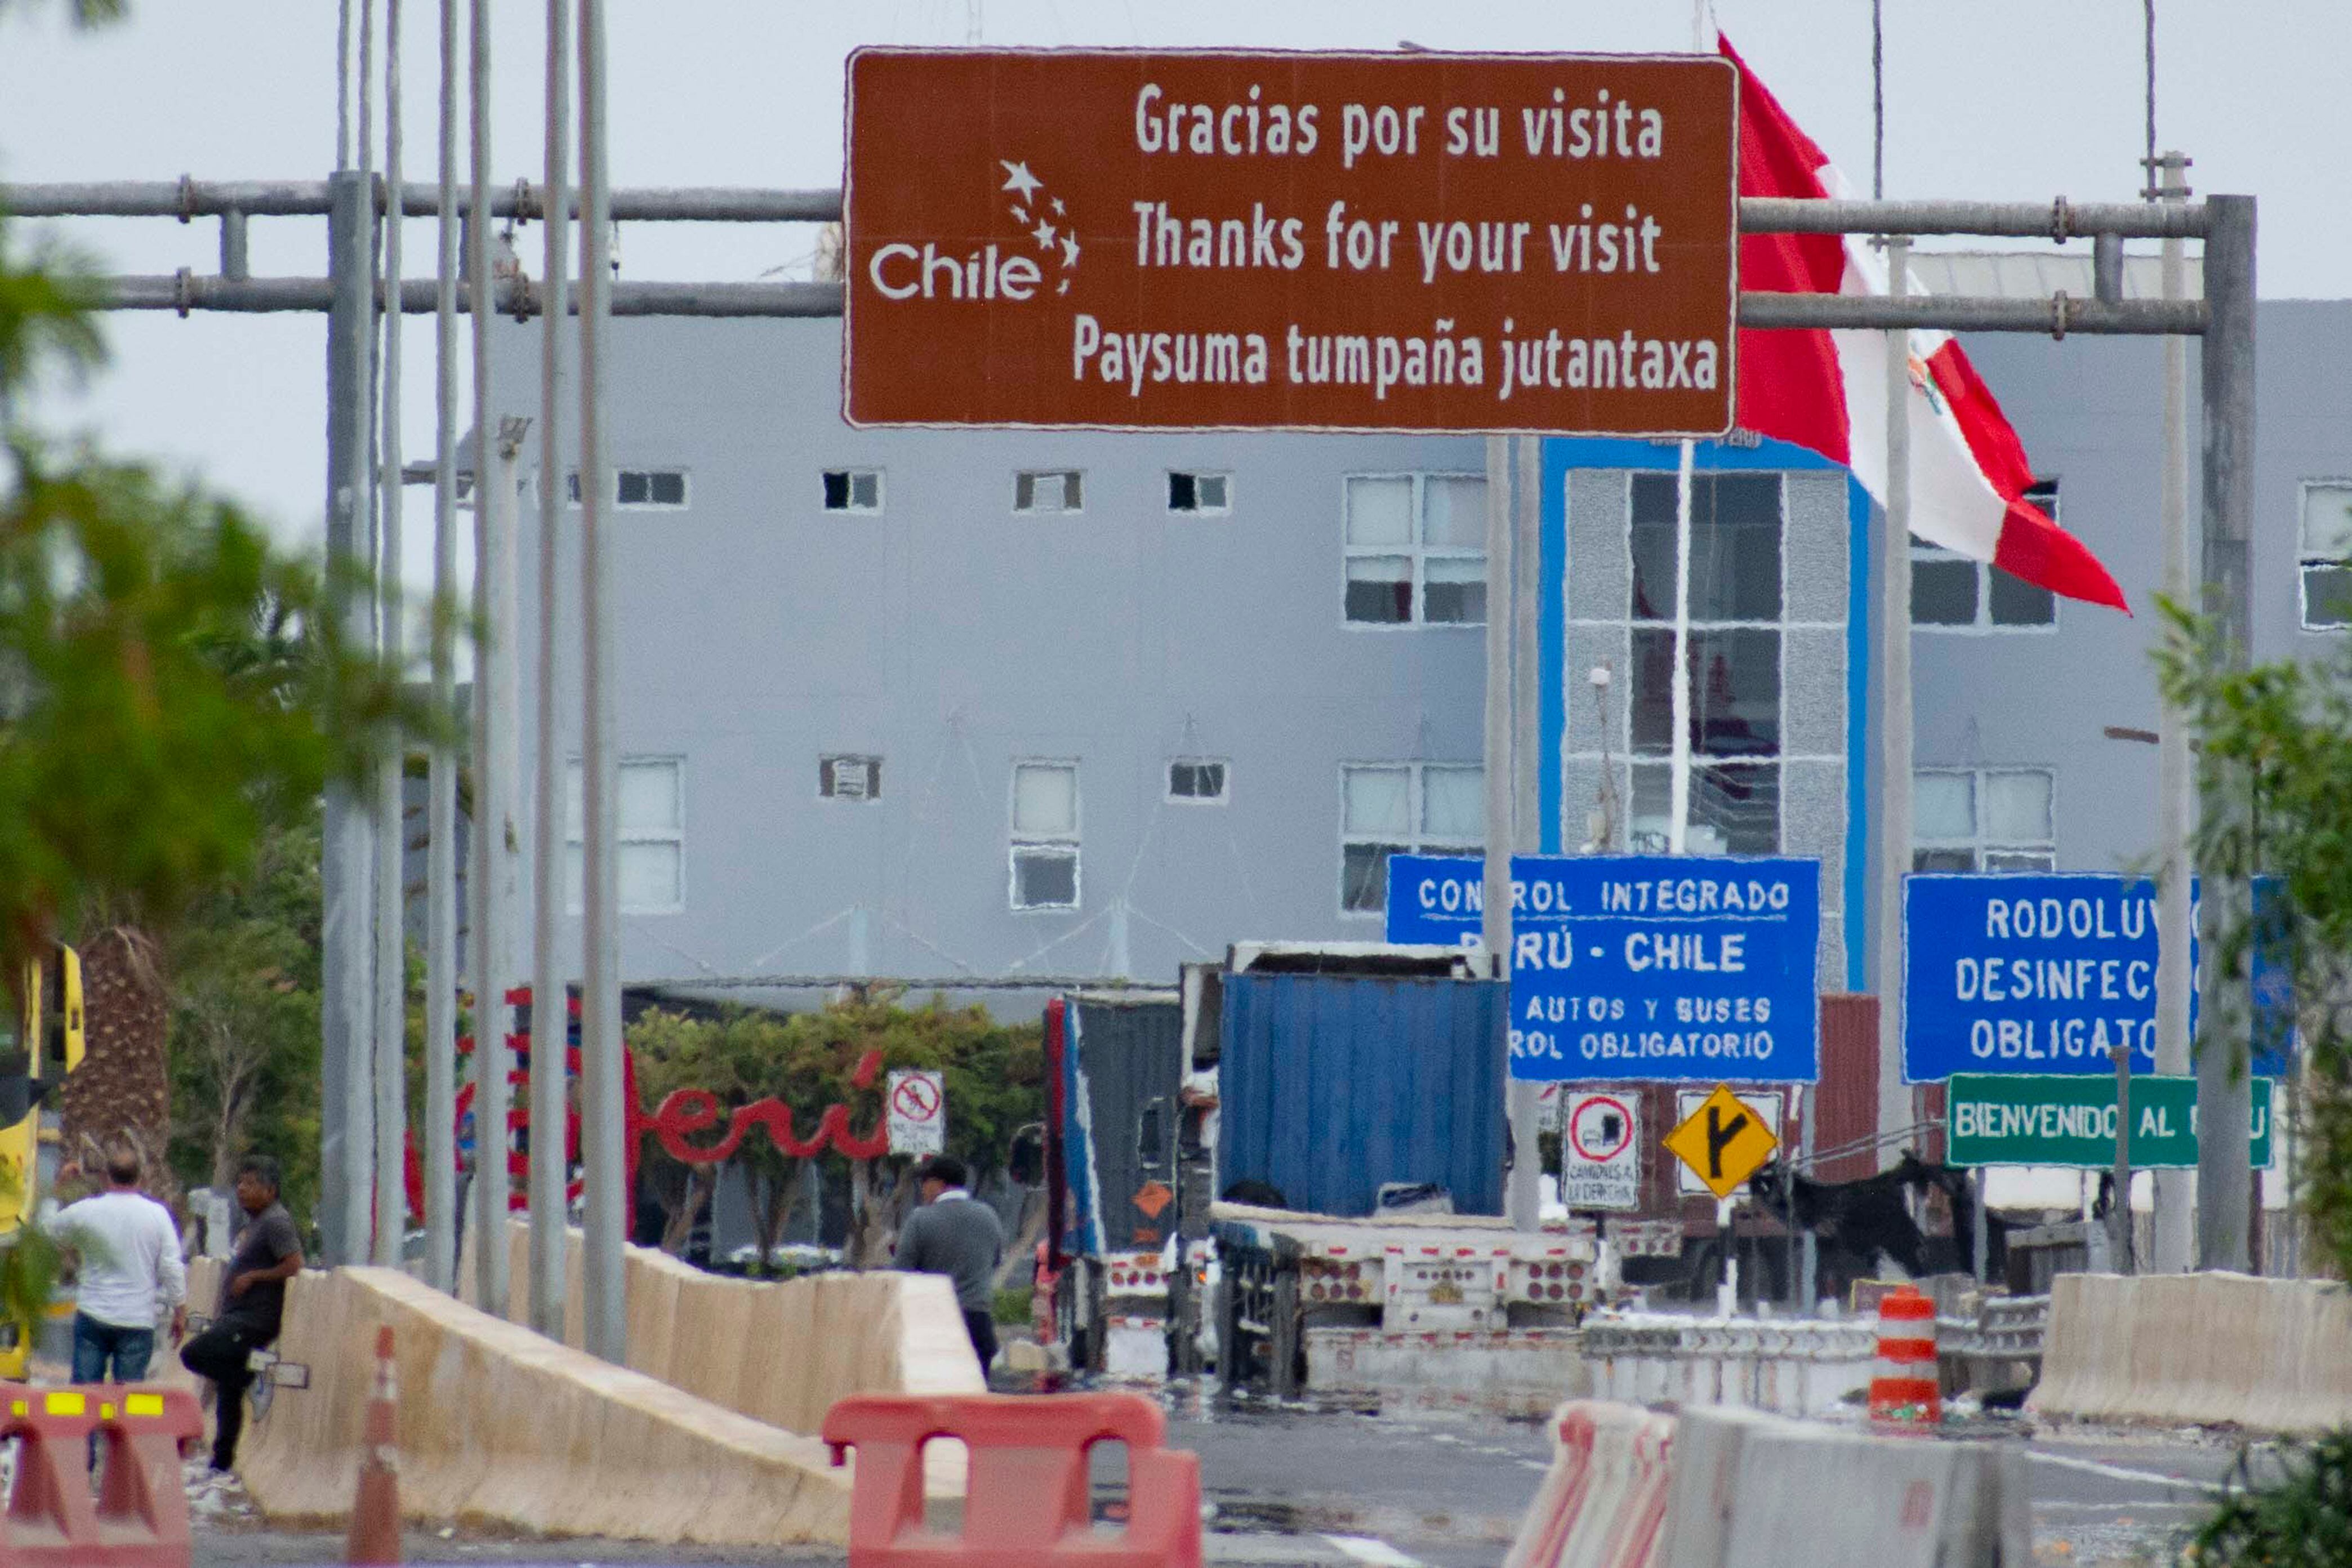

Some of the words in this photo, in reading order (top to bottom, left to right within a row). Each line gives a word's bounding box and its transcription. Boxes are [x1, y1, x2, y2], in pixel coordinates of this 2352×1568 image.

[1135, 83, 1318, 156] Gracias
[1342, 104, 1425, 169] por
[1446, 106, 1499, 157] su
[1522, 87, 1663, 159] visita
[1133, 201, 1305, 270] Thanks
[1325, 200, 1399, 271] for
[1417, 221, 1530, 284] your
[1549, 203, 1661, 273] visit
[868, 244, 1043, 301] Chile
[1073, 314, 1269, 398] Paysuma
[1286, 318, 1484, 400] tumpaña
[1498, 318, 1718, 401] jutantaxa
[1418, 879, 1571, 912] CONROL
[1602, 879, 1789, 912] INTEGRADO
[1986, 898, 2201, 939] RODOLU
[1624, 932, 1745, 973] CHILE
[1956, 957, 2200, 1001] DESINFEC
[1526, 995, 1625, 1023] AUTOS
[1644, 998, 1658, 1020] Y
[1675, 997, 1771, 1023] BUSES
[1580, 1030, 1774, 1061] OBLIGATORIO
[1971, 1018, 2199, 1059] OBLIGATO
[1955, 1102, 2118, 1139] BIENVENIDO
[2139, 1106, 2176, 1138] AL
